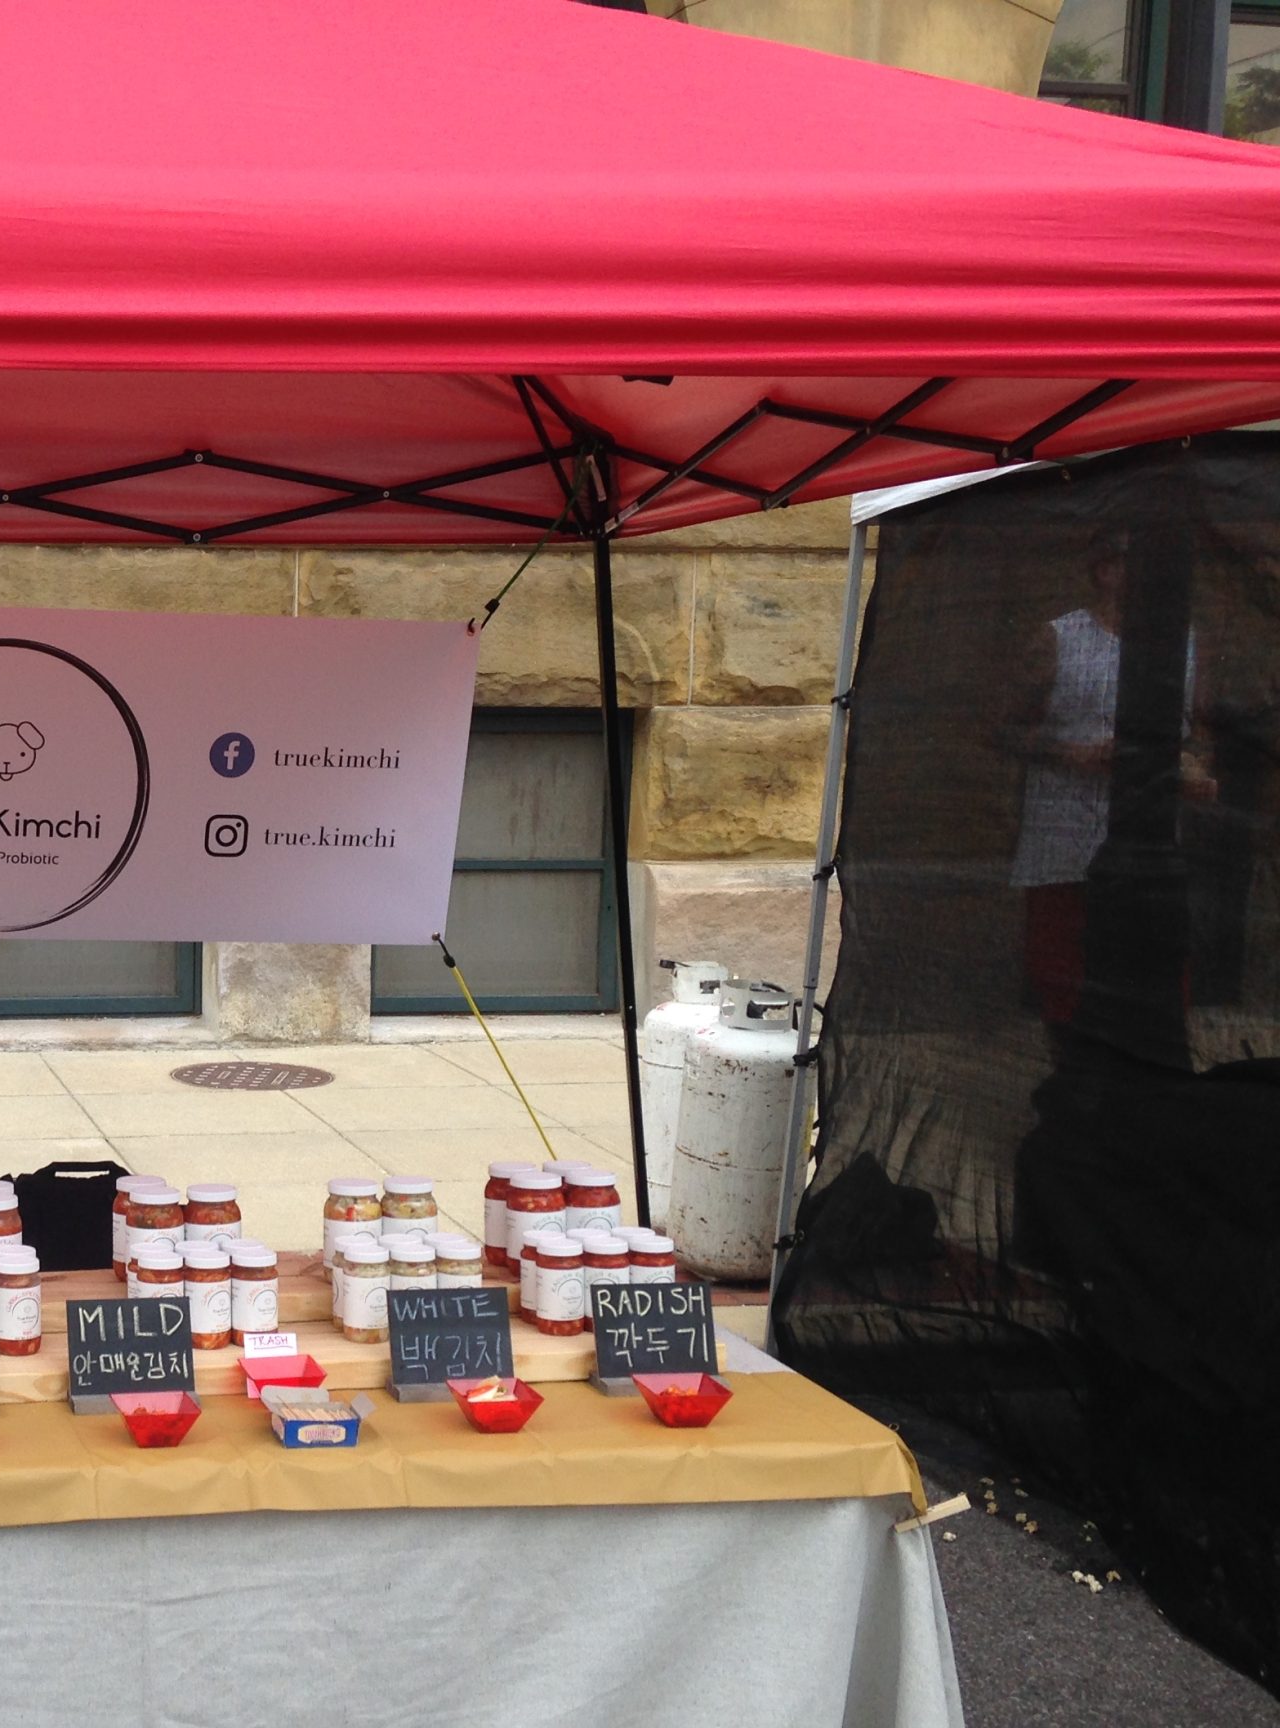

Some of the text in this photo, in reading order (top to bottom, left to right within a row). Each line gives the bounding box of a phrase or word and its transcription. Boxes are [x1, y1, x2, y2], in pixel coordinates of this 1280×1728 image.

[274, 747, 400, 769] truekimchi
[264, 826, 396, 848] true.kimchi
[393, 1293, 498, 1321] WHITE
[597, 1286, 705, 1317] RADISH
[79, 1303, 184, 1342] MILD
[248, 1335, 288, 1347] TRASH
[606, 1322, 709, 1368] 깍두기
[400, 1332, 502, 1380] 백김치
